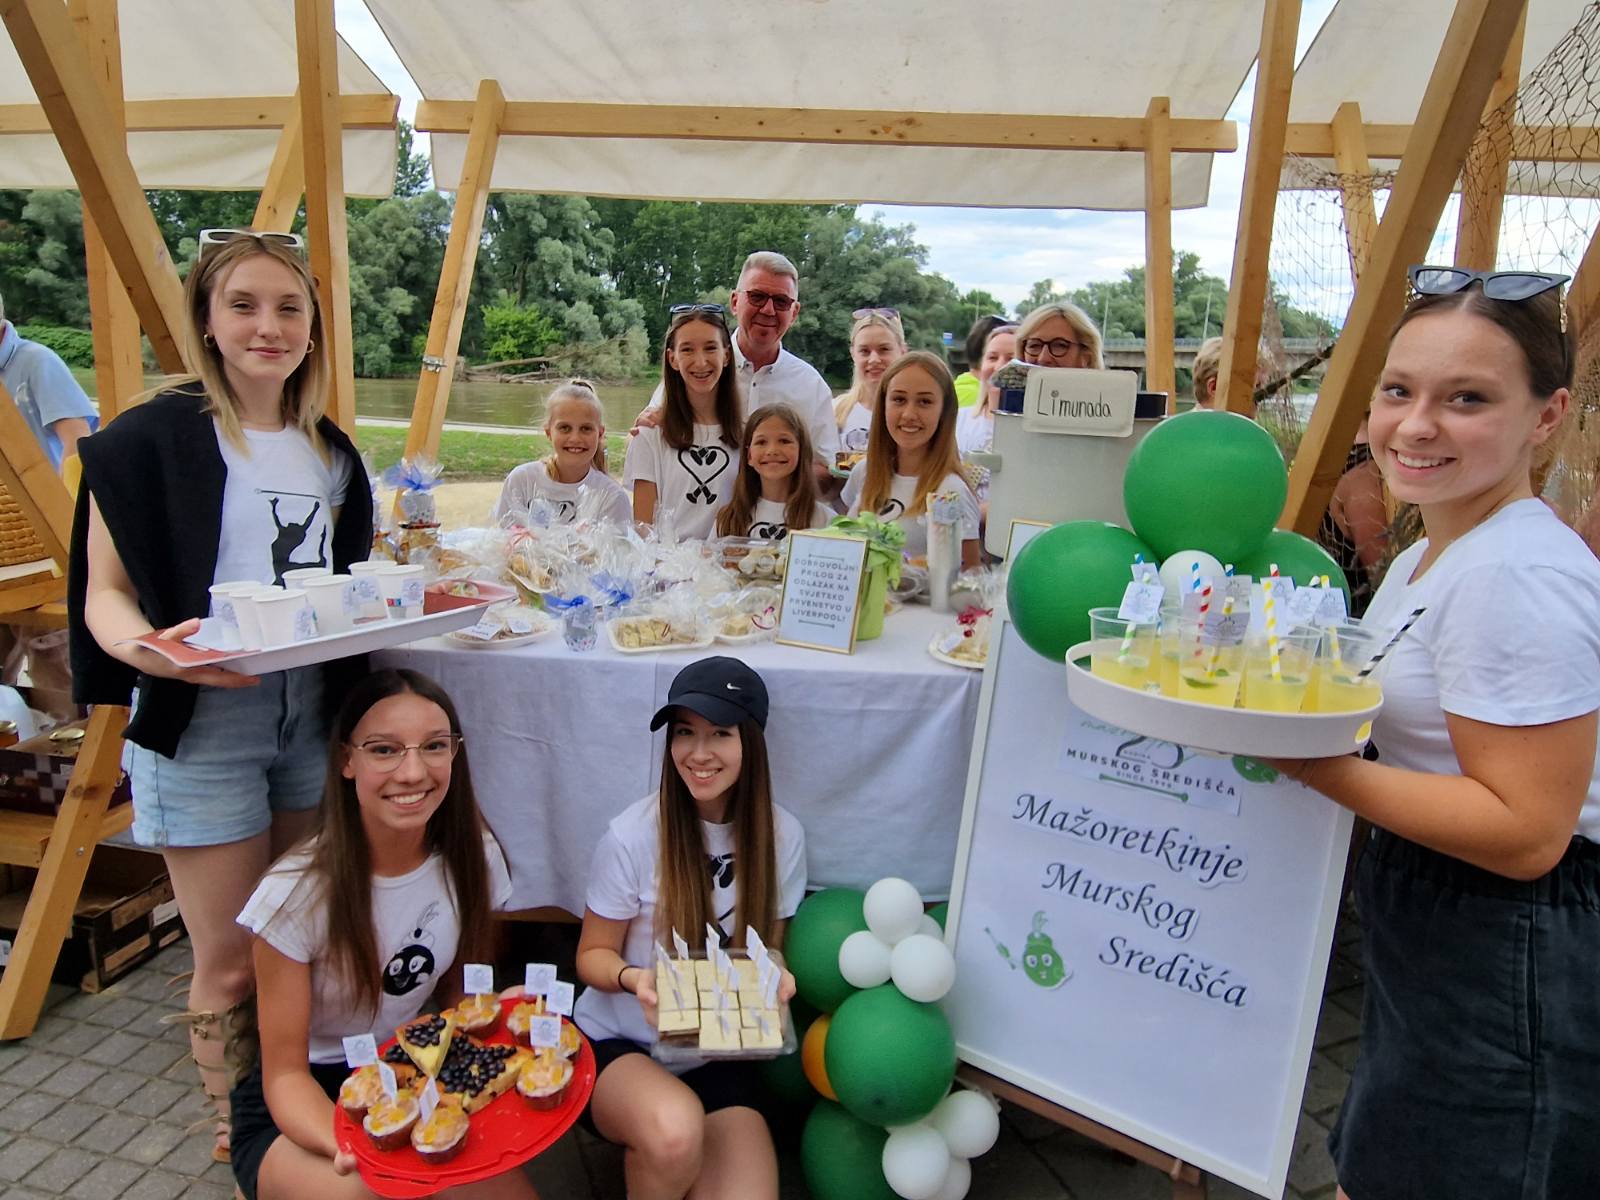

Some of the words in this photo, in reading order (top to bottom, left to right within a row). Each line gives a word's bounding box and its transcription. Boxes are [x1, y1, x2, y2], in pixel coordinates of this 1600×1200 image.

[1037, 378, 1112, 418] Limunada
[793, 578, 834, 589] ODLAZAK
[1067, 748, 1142, 773] MURSKOG
[1151, 768, 1236, 796] SREDIŠĆA
[1012, 793, 1244, 883] Mažoretkinje
[1041, 862, 1198, 939] Murskog
[1098, 935, 1248, 1008] Središća
